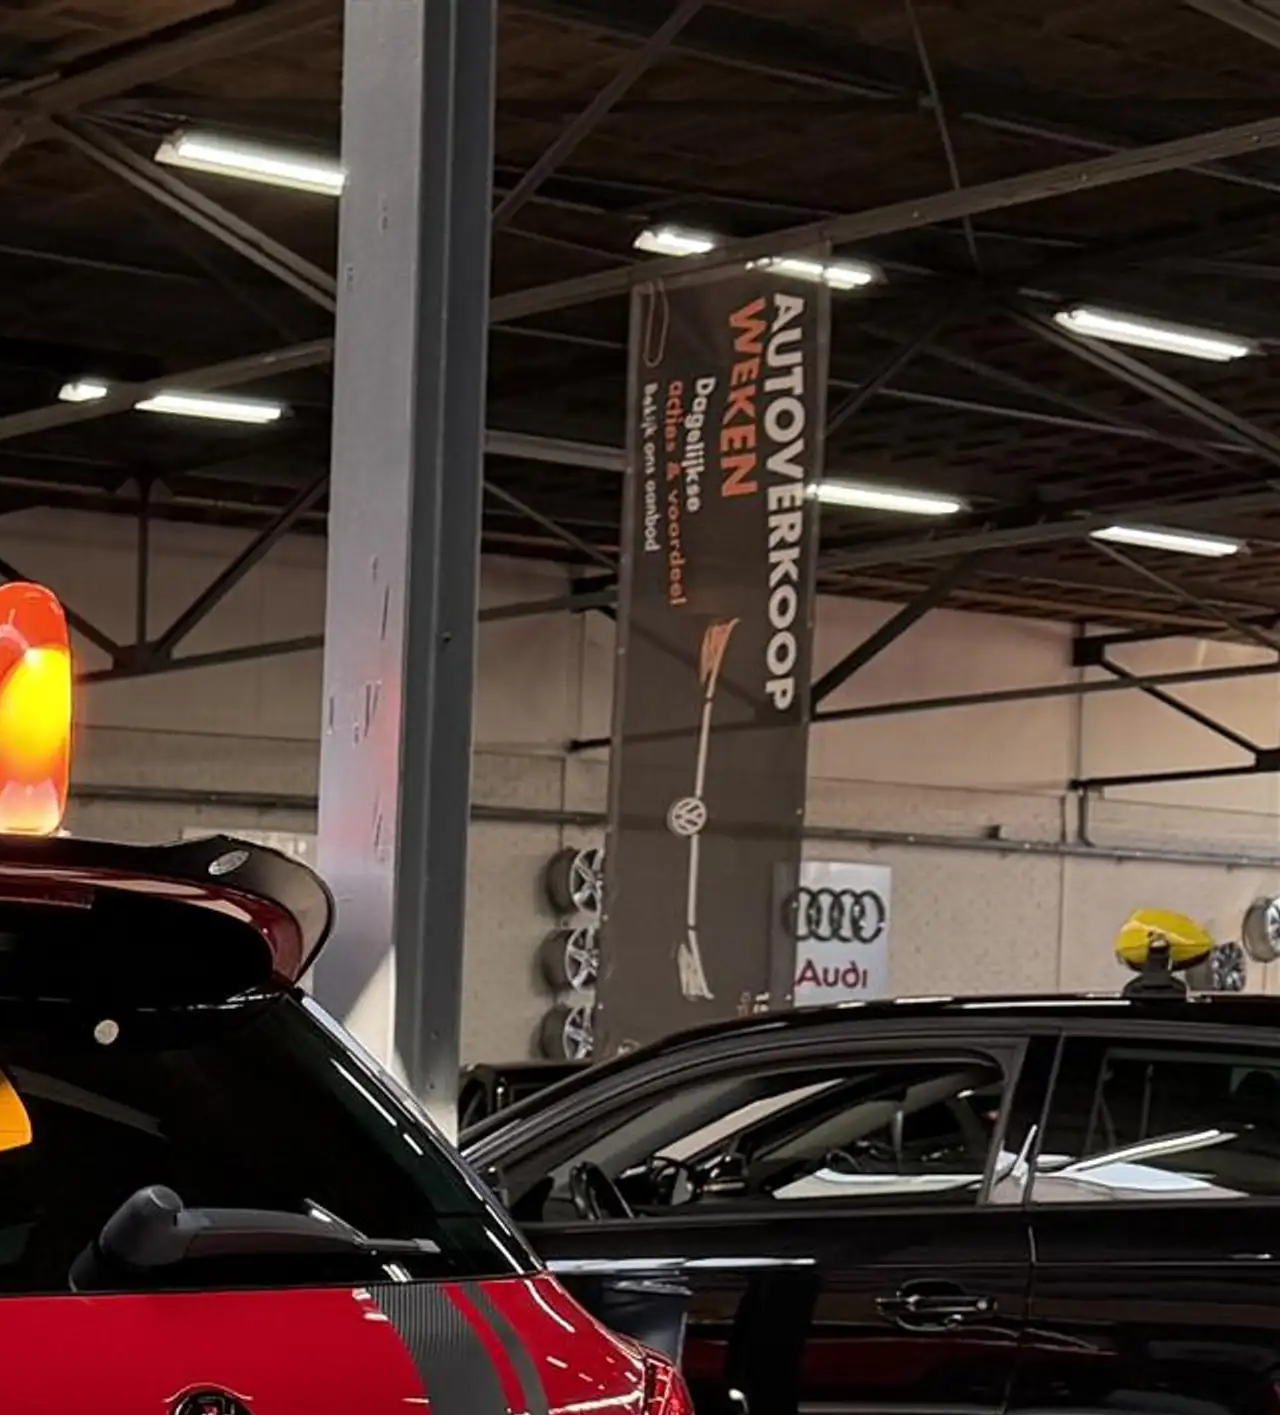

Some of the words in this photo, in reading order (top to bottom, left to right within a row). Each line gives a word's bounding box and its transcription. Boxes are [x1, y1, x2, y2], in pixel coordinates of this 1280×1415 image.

[665, 381, 684, 452] acties
[720, 296, 767, 497] WEKEN
[643, 442, 656, 474] ons
[681, 377, 717, 513] Dagelijkse
[643, 480, 661, 551] aanbod
[667, 489, 687, 606] voordeel
[763, 292, 806, 710] AUTOVERKOOP
[793, 958, 869, 989] Audi
